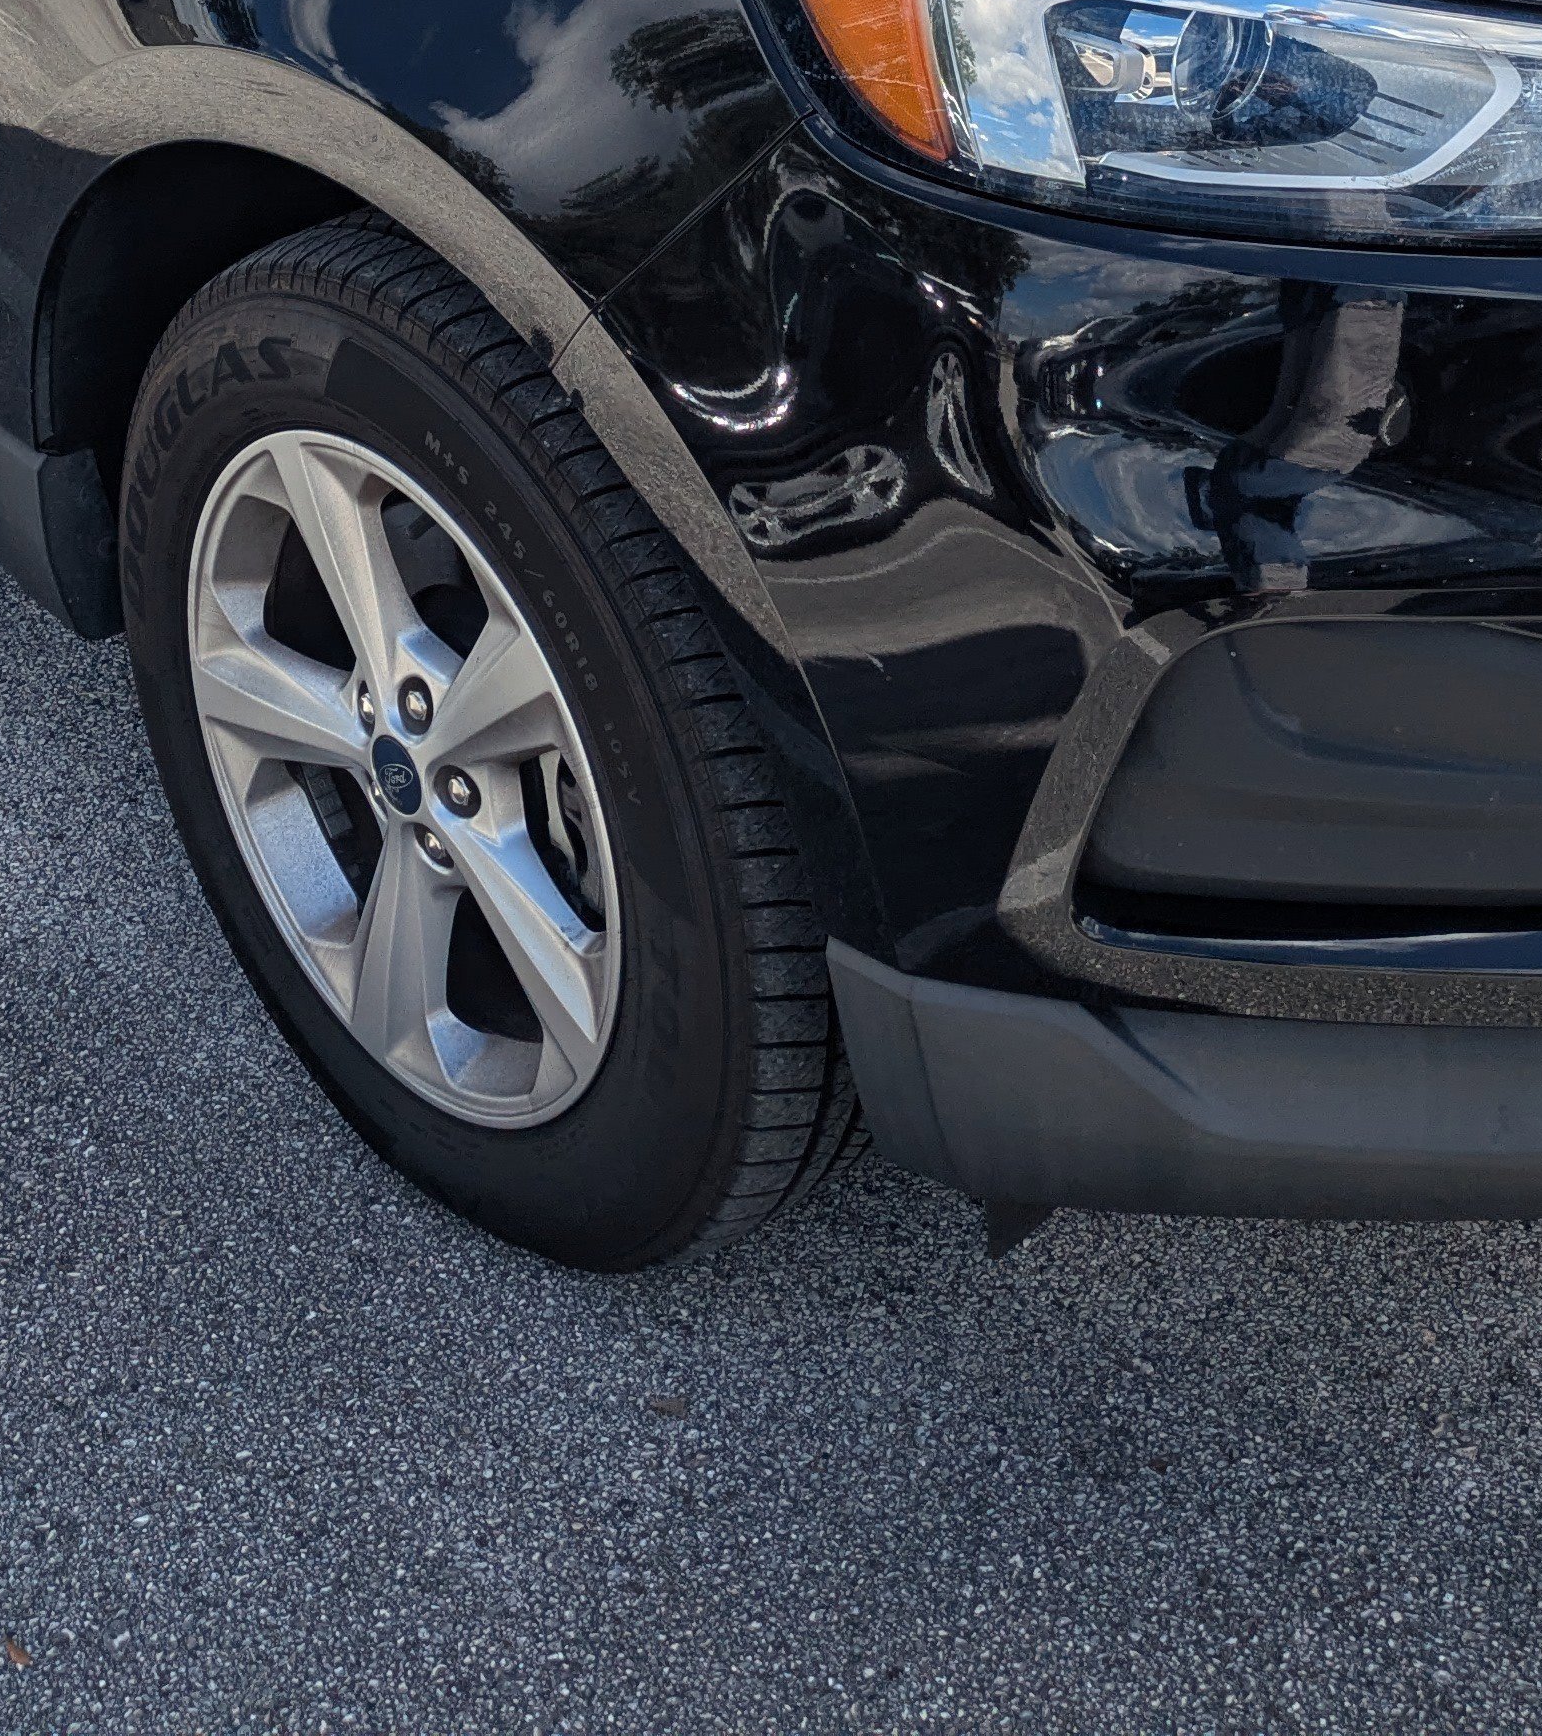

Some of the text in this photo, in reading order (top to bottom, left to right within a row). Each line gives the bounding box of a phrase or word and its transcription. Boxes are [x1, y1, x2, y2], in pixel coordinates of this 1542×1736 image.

[121, 336, 293, 616] DOUGLAS
[424, 430, 469, 486] M+S
[483, 500, 599, 692] 245/60R18
[384, 767, 407, 785] Ford
